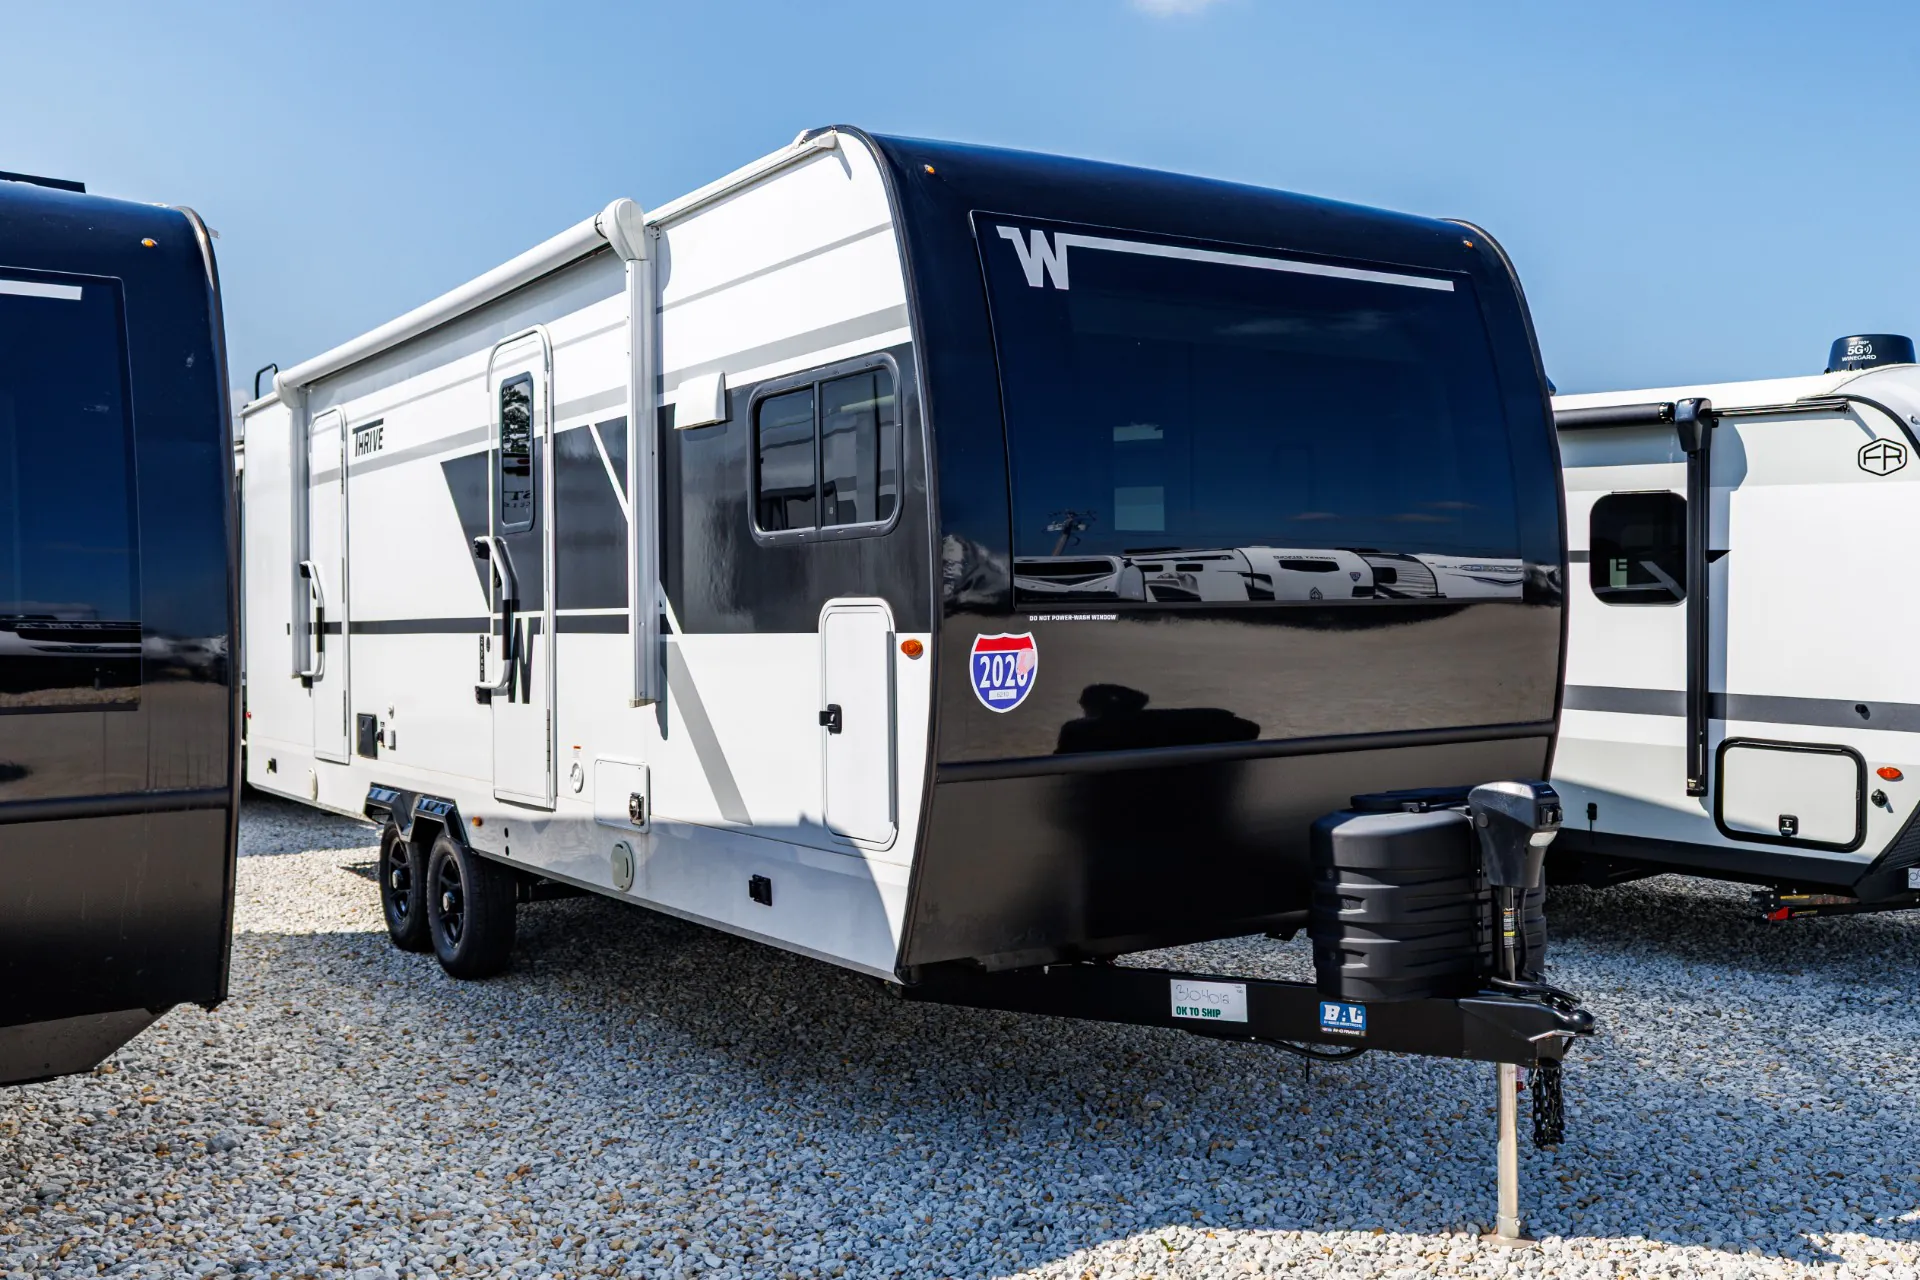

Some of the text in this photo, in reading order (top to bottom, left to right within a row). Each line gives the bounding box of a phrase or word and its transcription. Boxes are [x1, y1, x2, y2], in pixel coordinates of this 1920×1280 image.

[1847, 345, 1864, 355] 5G
[1841, 354, 1877, 362] WINEGARD
[352, 418, 384, 457] THRIVE
[1176, 1006, 1221, 1018] OK TO SHIP
[1323, 1004, 1363, 1024] BAL
